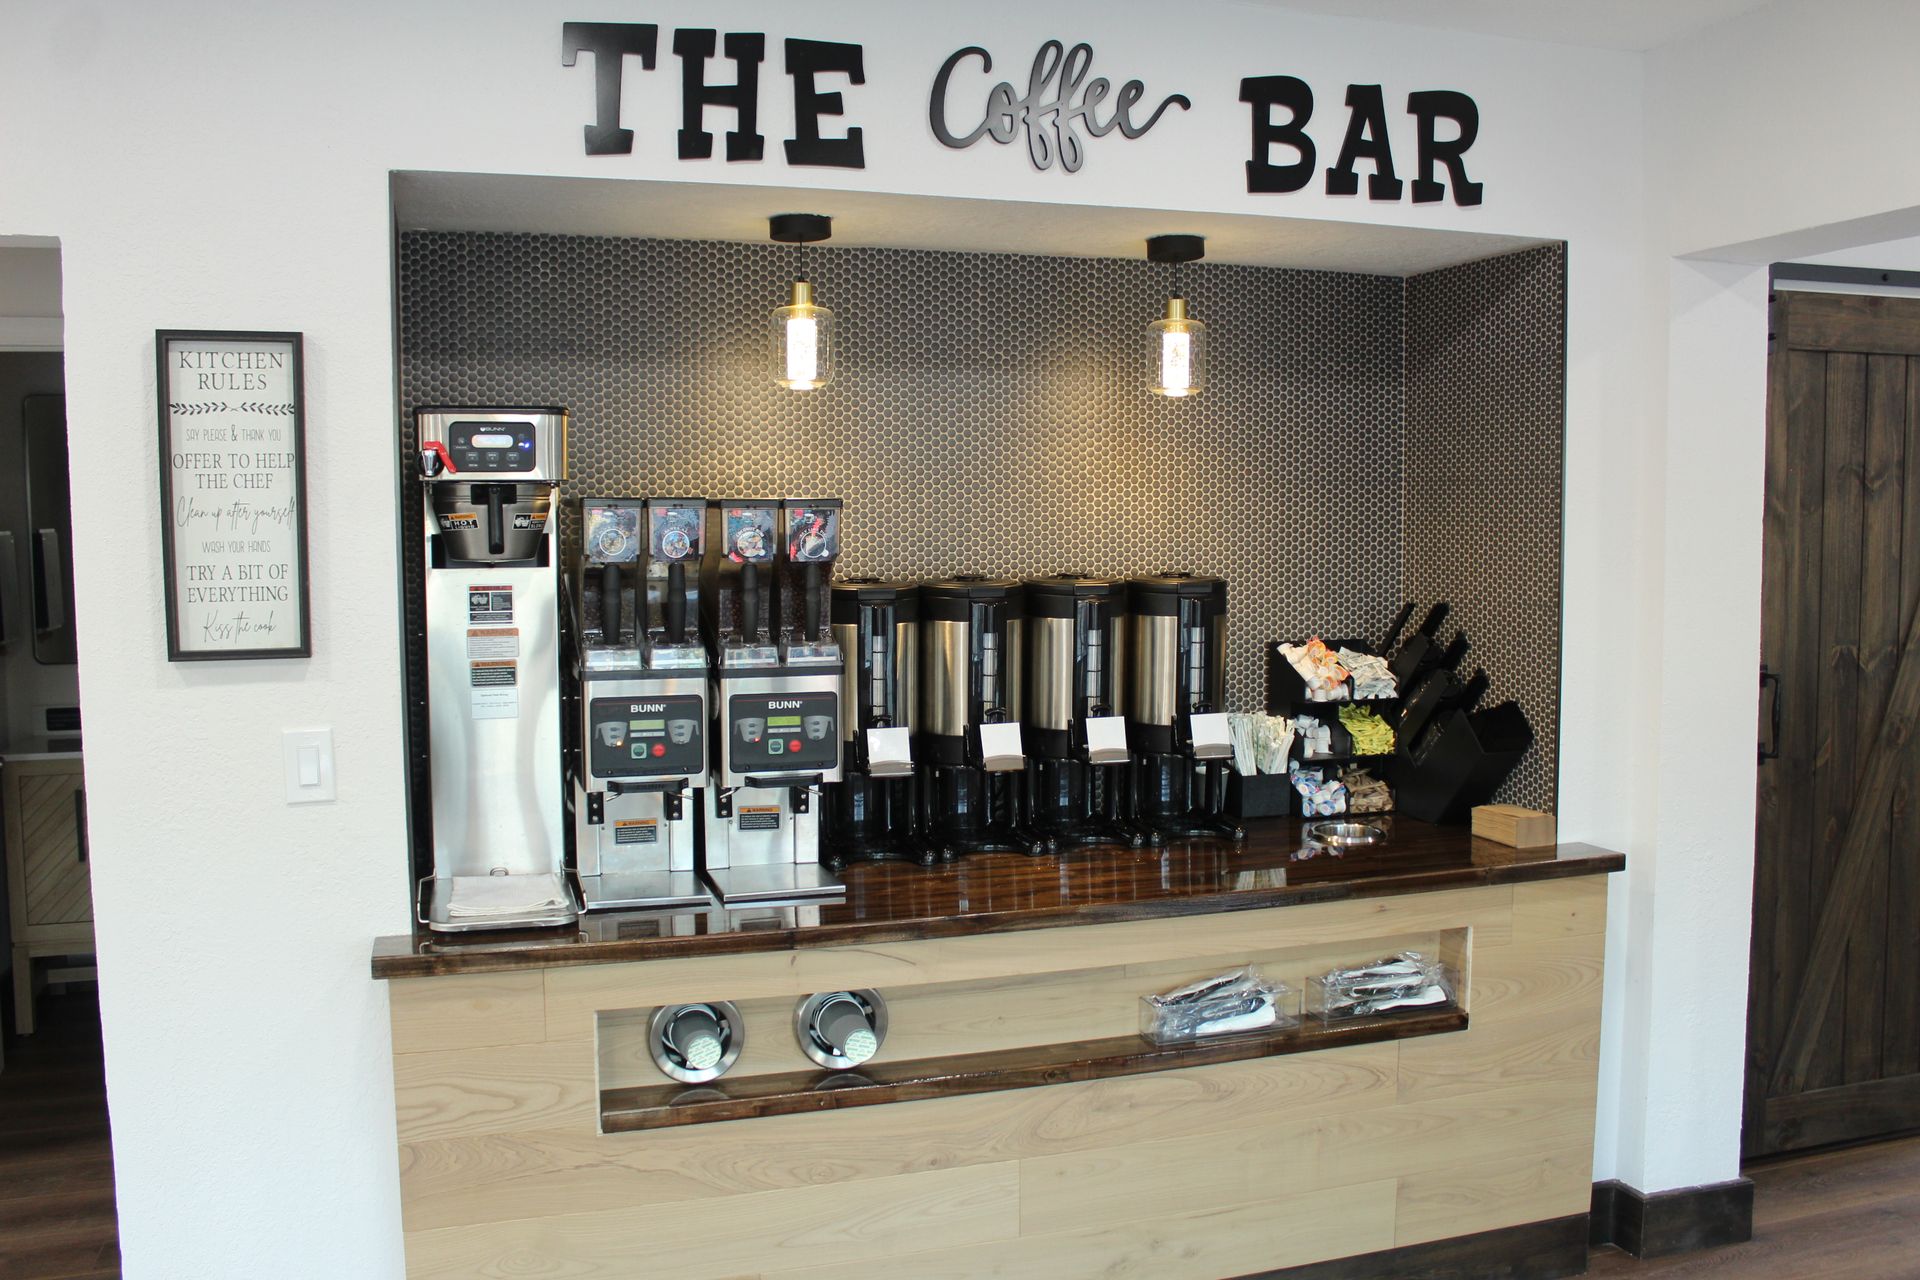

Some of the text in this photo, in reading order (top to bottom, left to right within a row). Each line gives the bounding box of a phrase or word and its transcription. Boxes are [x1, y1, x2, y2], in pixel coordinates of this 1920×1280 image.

[562, 21, 1484, 207] THE Coffee BAR
[179, 351, 283, 369] KITCHEN
[198, 372, 267, 390] RULES
[186, 424, 282, 442] SAY PLEASE & THANK YOU
[173, 453, 295, 469] OFFER TO HELP
[195, 473, 274, 489] THE CHEF
[177, 495, 296, 535] Clean up after yourself
[202, 541, 271, 553] WASH YOUR HANDS
[186, 564, 288, 581] TRY A BIT OF
[187, 586, 289, 603] EVERYTHING
[203, 609, 277, 643] Kiss the cook
[630, 704, 664, 713] BUNN
[768, 701, 801, 709] BUNN
